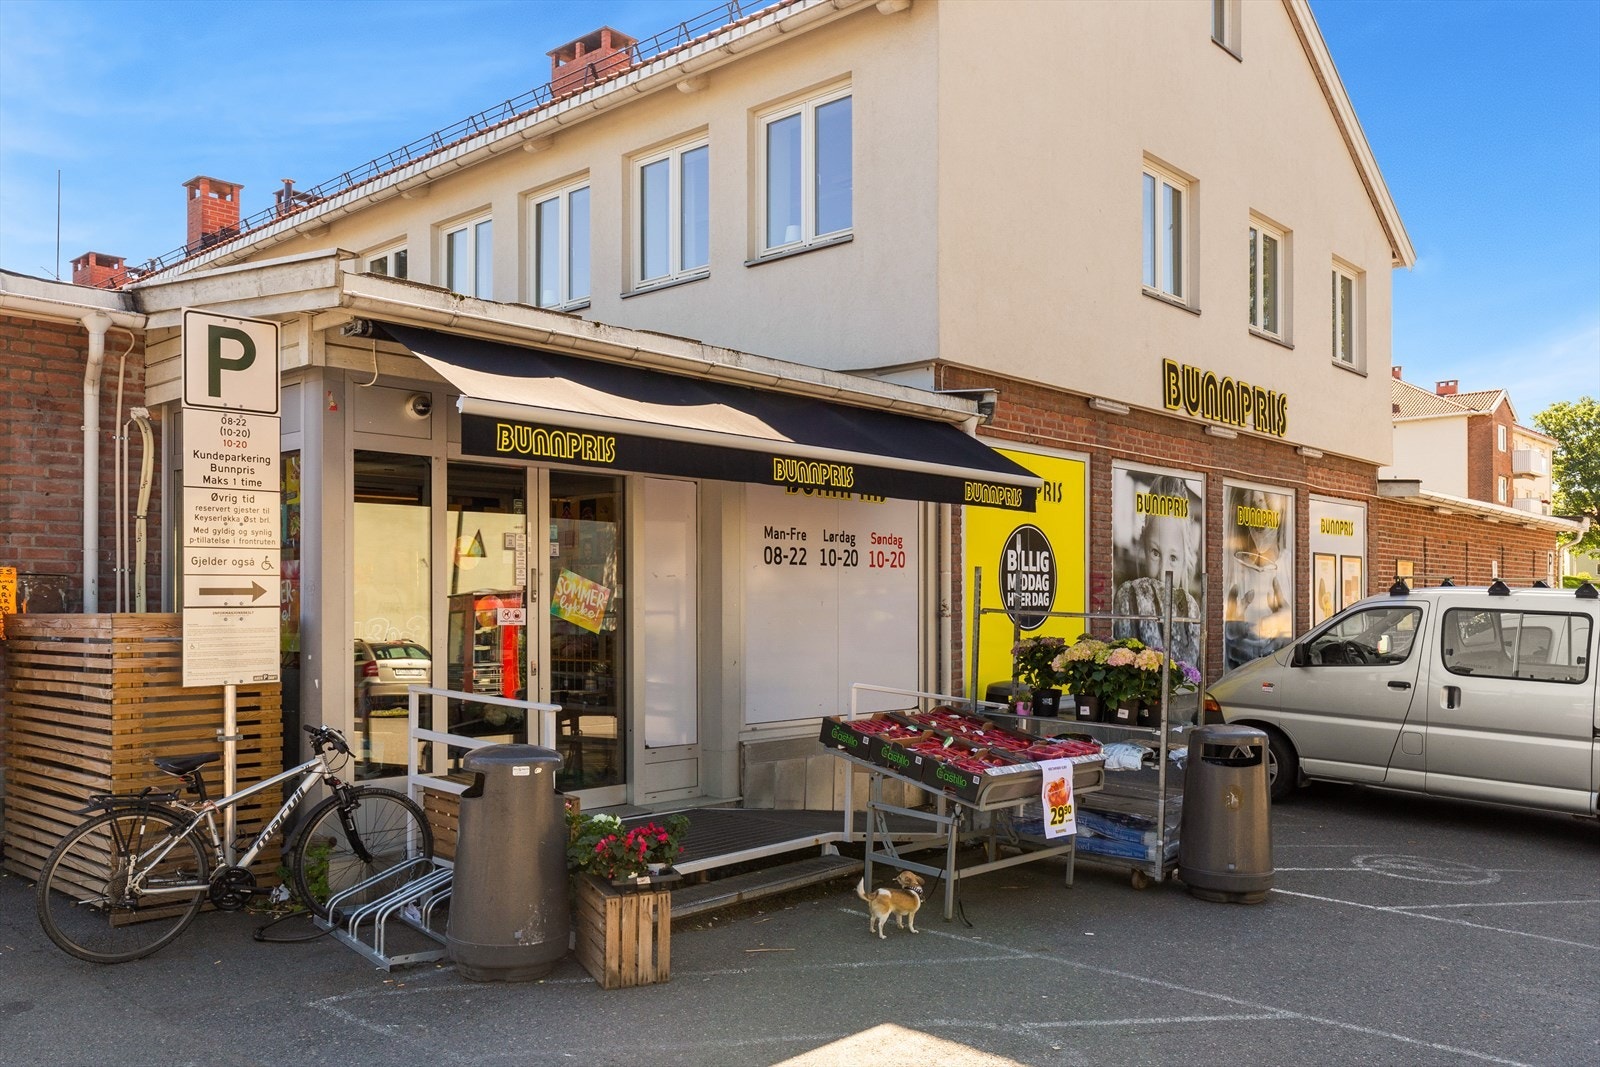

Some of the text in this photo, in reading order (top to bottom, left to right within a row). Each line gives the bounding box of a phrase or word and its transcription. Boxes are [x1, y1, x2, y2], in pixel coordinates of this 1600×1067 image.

[208, 324, 256, 397] P
[1163, 358, 1287, 437] BUNNPRIS
[221, 417, 246, 426] 08-22
[220, 426, 250, 438] (10-20)
[223, 440, 247, 448] 10-20
[496, 423, 616, 462] BUNNPRIS
[193, 450, 271, 466] Kundeparkering
[210, 463, 255, 475] Bunnpris
[773, 458, 854, 488] BUNNPRIS
[202, 475, 228, 485] Maks
[241, 478, 262, 487] time
[211, 492, 255, 504] Øvrig tid
[964, 482, 1022, 507] BUNNPRIS
[1136, 492, 1189, 520] BUNNPRIS
[194, 514, 240, 522] Keyserløkka
[1237, 505, 1280, 530] BUNNPRIS
[213, 528, 235, 536] gyldig
[251, 529, 272, 537] synlig
[1320, 518, 1354, 537] BUNNPRIS
[764, 526, 903, 549] Man-Fre Lørdag Søndag
[191, 556, 255, 568] Gjelder også
[764, 546, 906, 568] 08-22 10-20 10-20
[1007, 549, 1050, 572] BILLIG
[1007, 574, 1050, 591] MDDAG
[1007, 592, 1050, 607] HER DAG
[936, 766, 967, 788] Castillo
